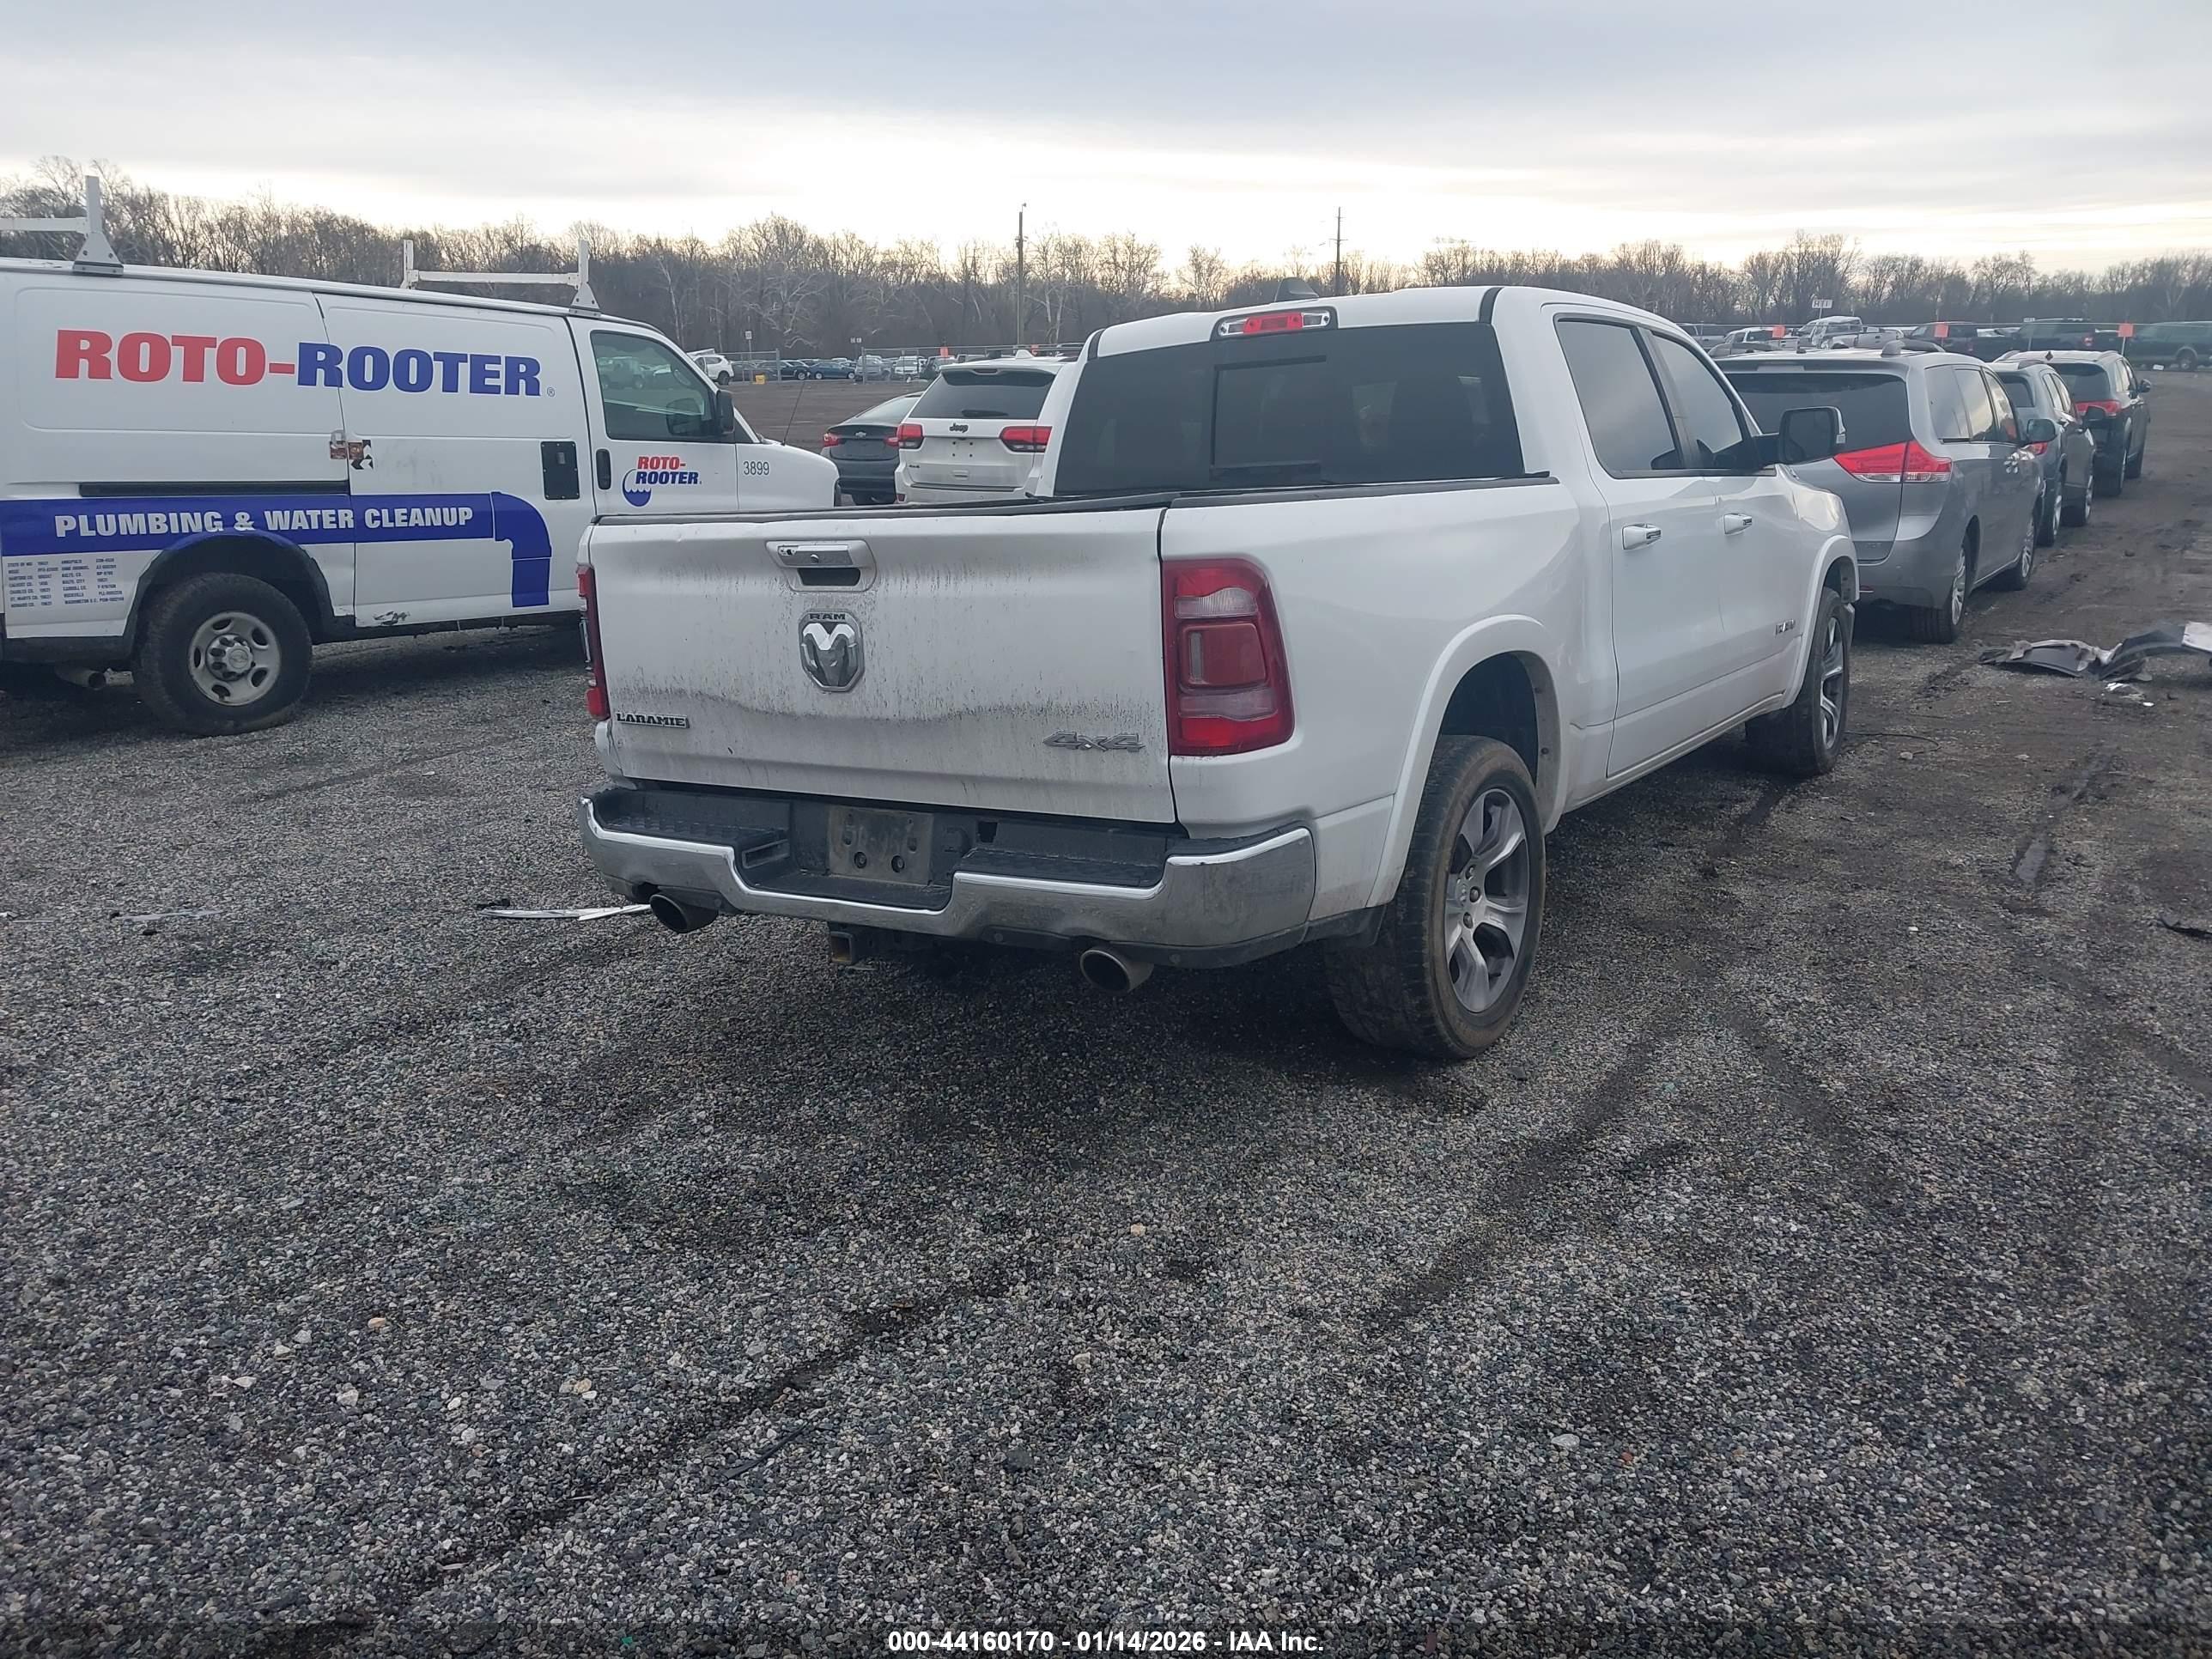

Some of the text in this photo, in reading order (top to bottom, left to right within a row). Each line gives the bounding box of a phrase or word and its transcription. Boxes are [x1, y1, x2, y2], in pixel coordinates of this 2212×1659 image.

[55, 328, 542, 397] ROTO-ROOTER
[949, 422, 969, 433] Jeep
[637, 456, 687, 471] ROTO-
[743, 461, 770, 476] 3899
[635, 471, 700, 485] ROOTER
[54, 507, 473, 538] PLUMBING & WATER CLEANUP
[616, 713, 686, 726] LARAMIE
